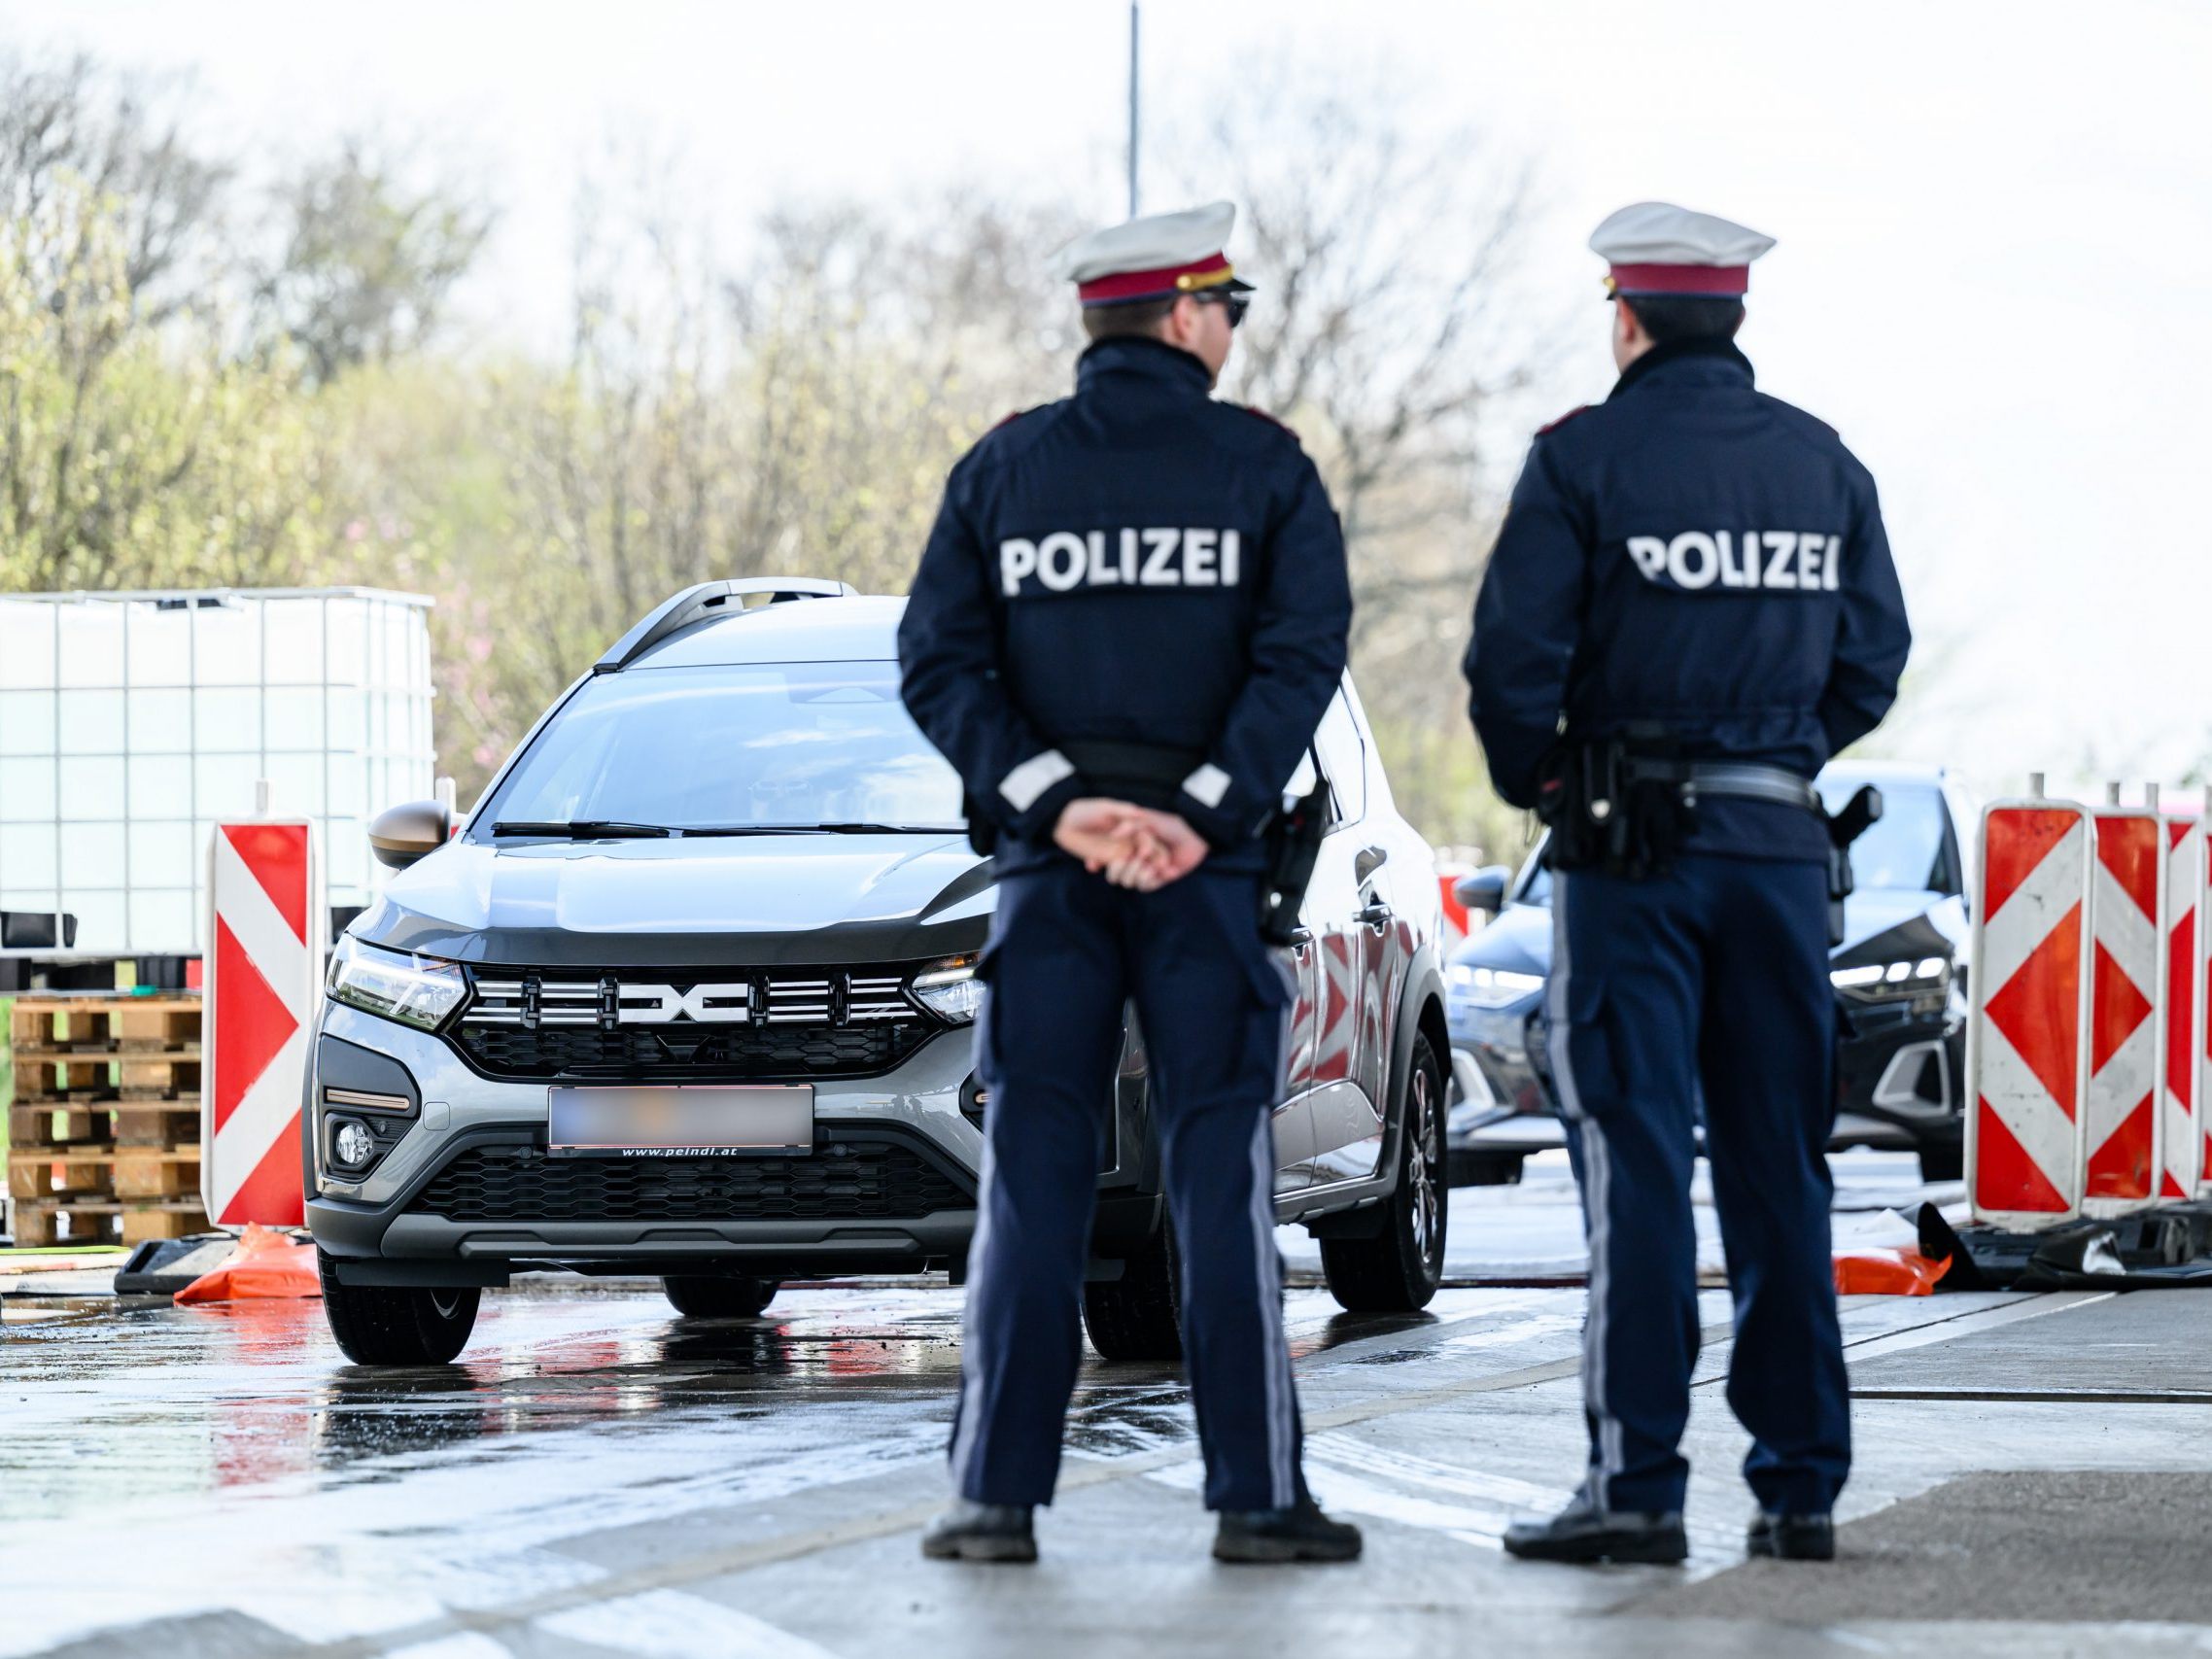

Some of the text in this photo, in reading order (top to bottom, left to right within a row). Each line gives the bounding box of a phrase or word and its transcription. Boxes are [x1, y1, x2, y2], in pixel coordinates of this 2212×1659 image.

[1000, 528, 1240, 597] POLIZEI
[1626, 531, 1842, 591] POLIZEI
[622, 1147, 739, 1158] www.peindl.at
